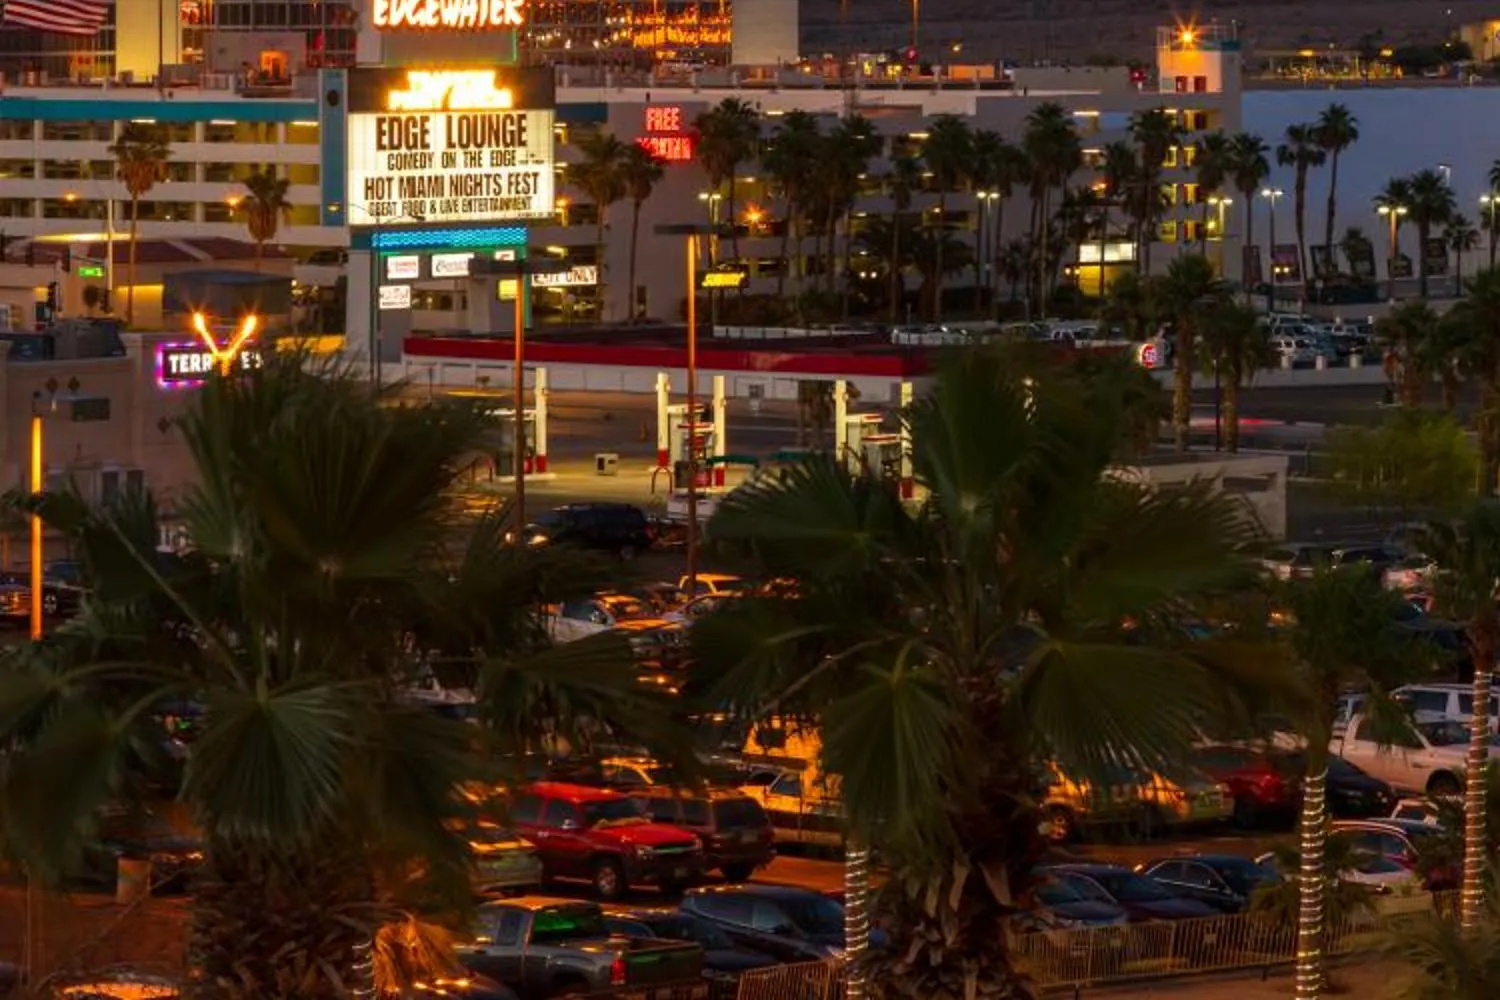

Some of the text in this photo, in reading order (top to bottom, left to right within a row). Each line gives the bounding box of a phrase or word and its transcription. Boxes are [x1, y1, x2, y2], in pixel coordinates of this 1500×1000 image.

[376, 113, 527, 150] EDGE LOUNGE
[646, 107, 680, 131] FREE
[387, 152, 435, 171] COMEDY
[441, 152, 457, 169] ON
[464, 151, 482, 168] THE
[490, 150, 516, 167] EDGE
[365, 172, 540, 200] HOT MIAMI NIGHTS FEST
